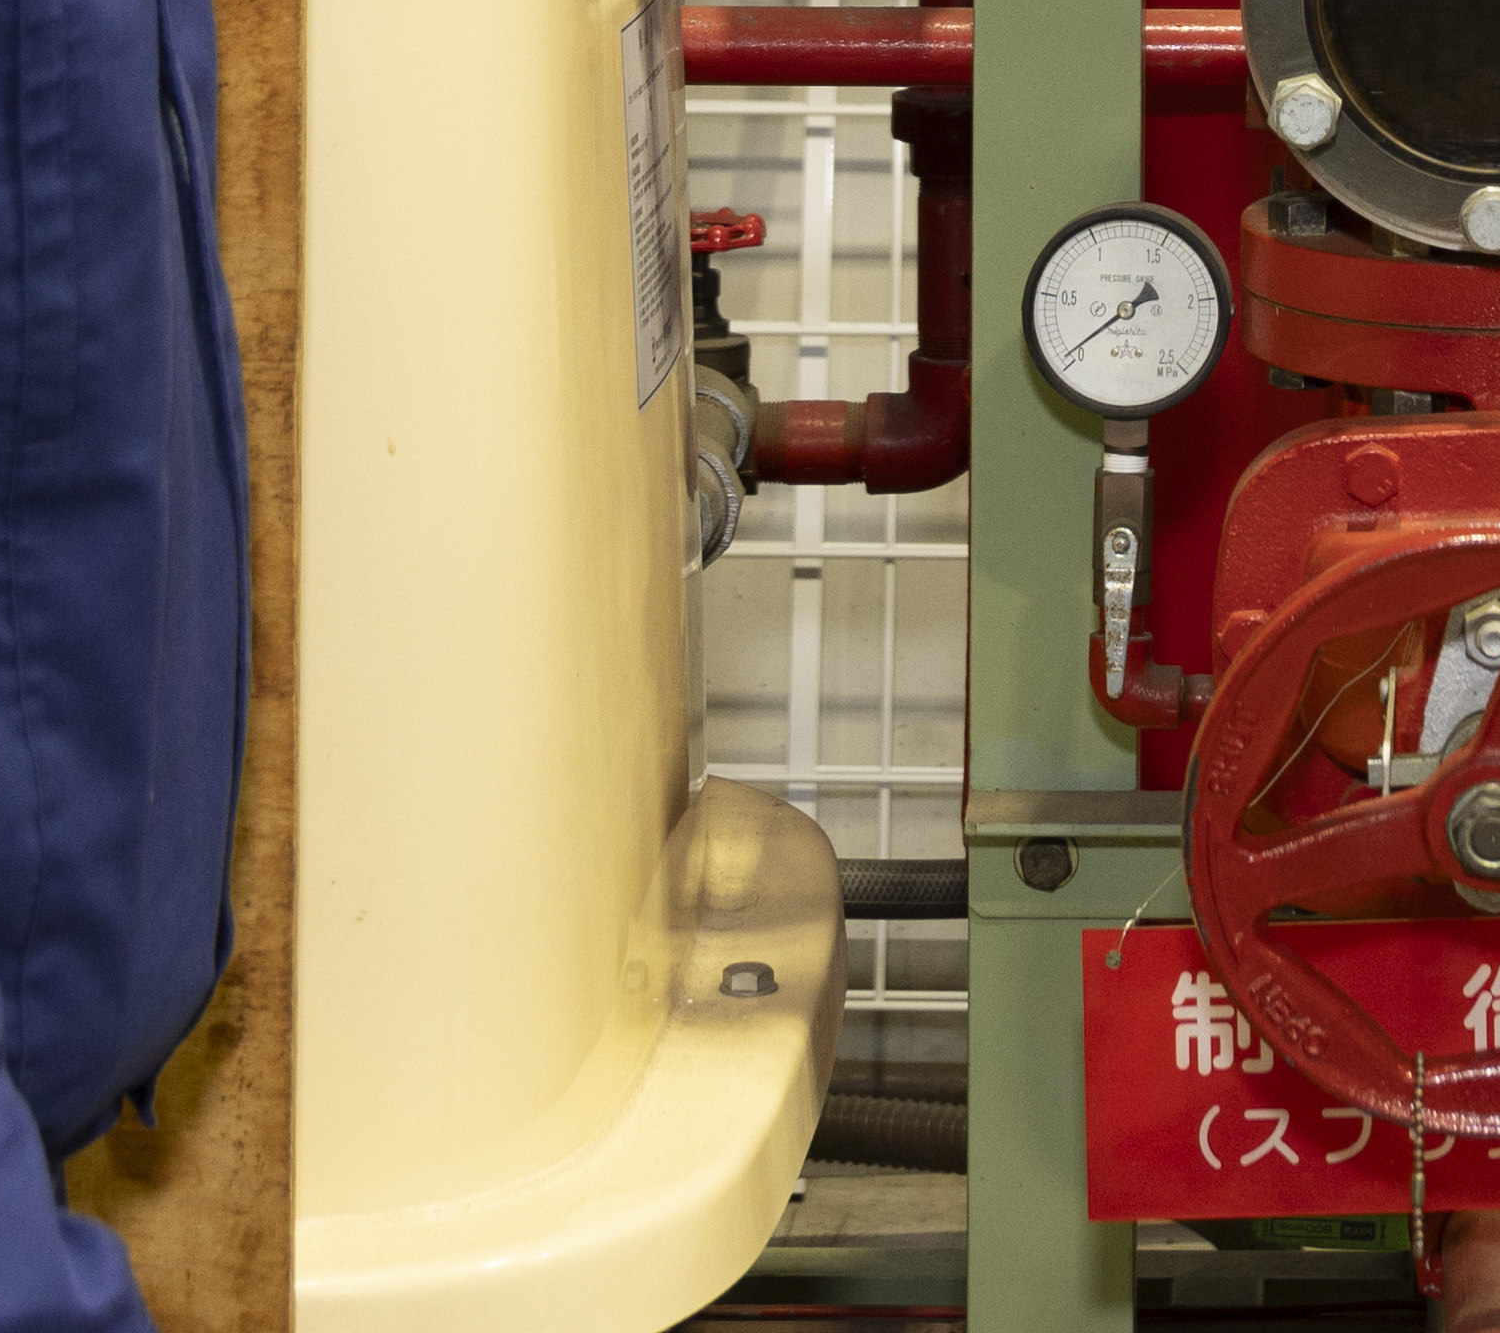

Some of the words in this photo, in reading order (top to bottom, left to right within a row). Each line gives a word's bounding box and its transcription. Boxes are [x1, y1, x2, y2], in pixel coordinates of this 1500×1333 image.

[1097, 247, 1103, 263] 1
[1146, 247, 1162, 264] 1.5
[1099, 273, 1132, 283] PRESSURE
[1135, 274, 1156, 284] GAUGE
[1061, 290, 1078, 307] 0.5
[1186, 293, 1195, 310] 2
[1077, 345, 1085, 363] 0
[1158, 349, 1175, 365] 2.5
[1156, 366, 1179, 379] MPa
